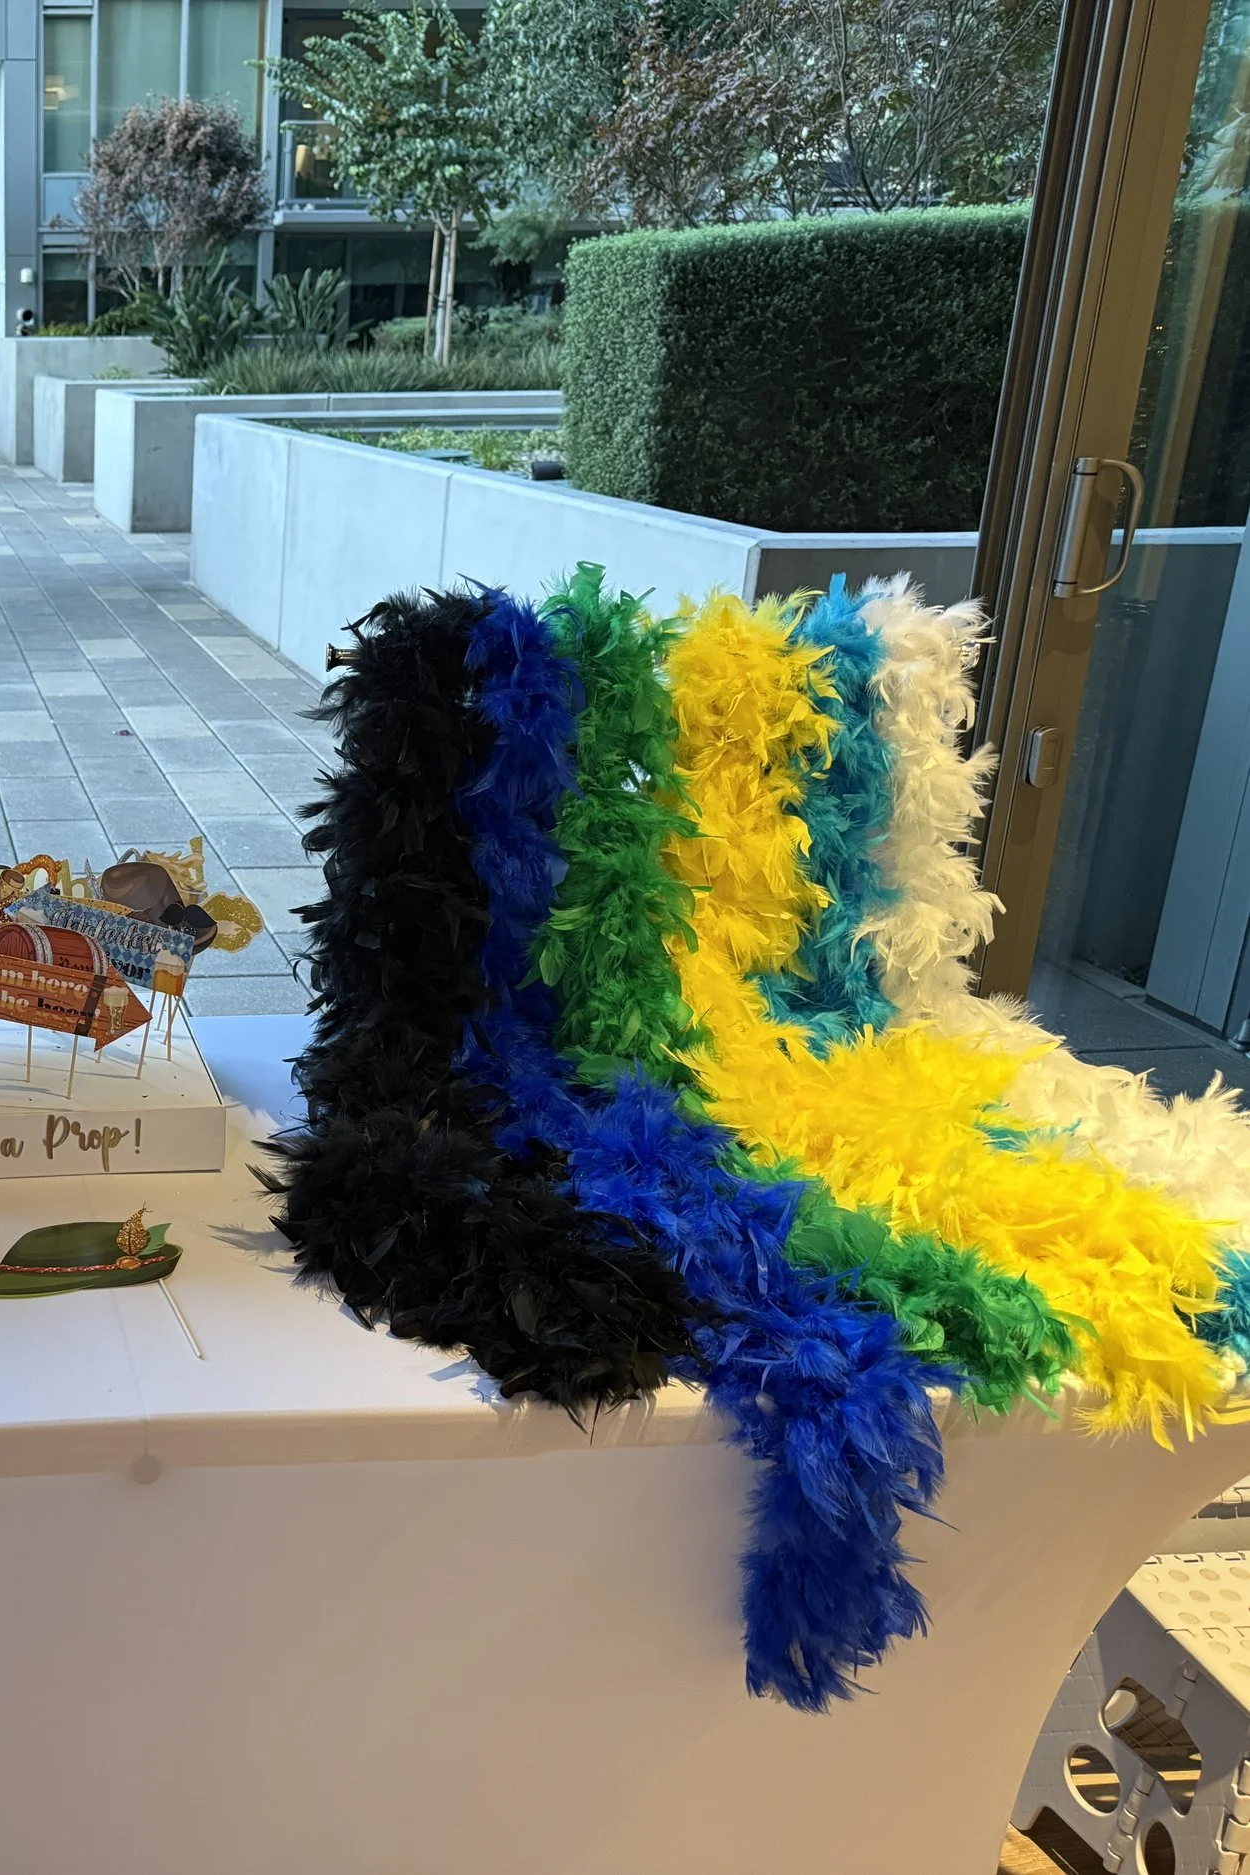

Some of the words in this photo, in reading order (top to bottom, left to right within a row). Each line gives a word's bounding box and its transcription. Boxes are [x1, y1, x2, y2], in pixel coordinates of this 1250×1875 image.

[53, 907, 162, 955] Oktoberfest
[28, 970, 88, 999] here
[0, 1137, 24, 1158] a
[43, 1114, 141, 1172] Prop!
